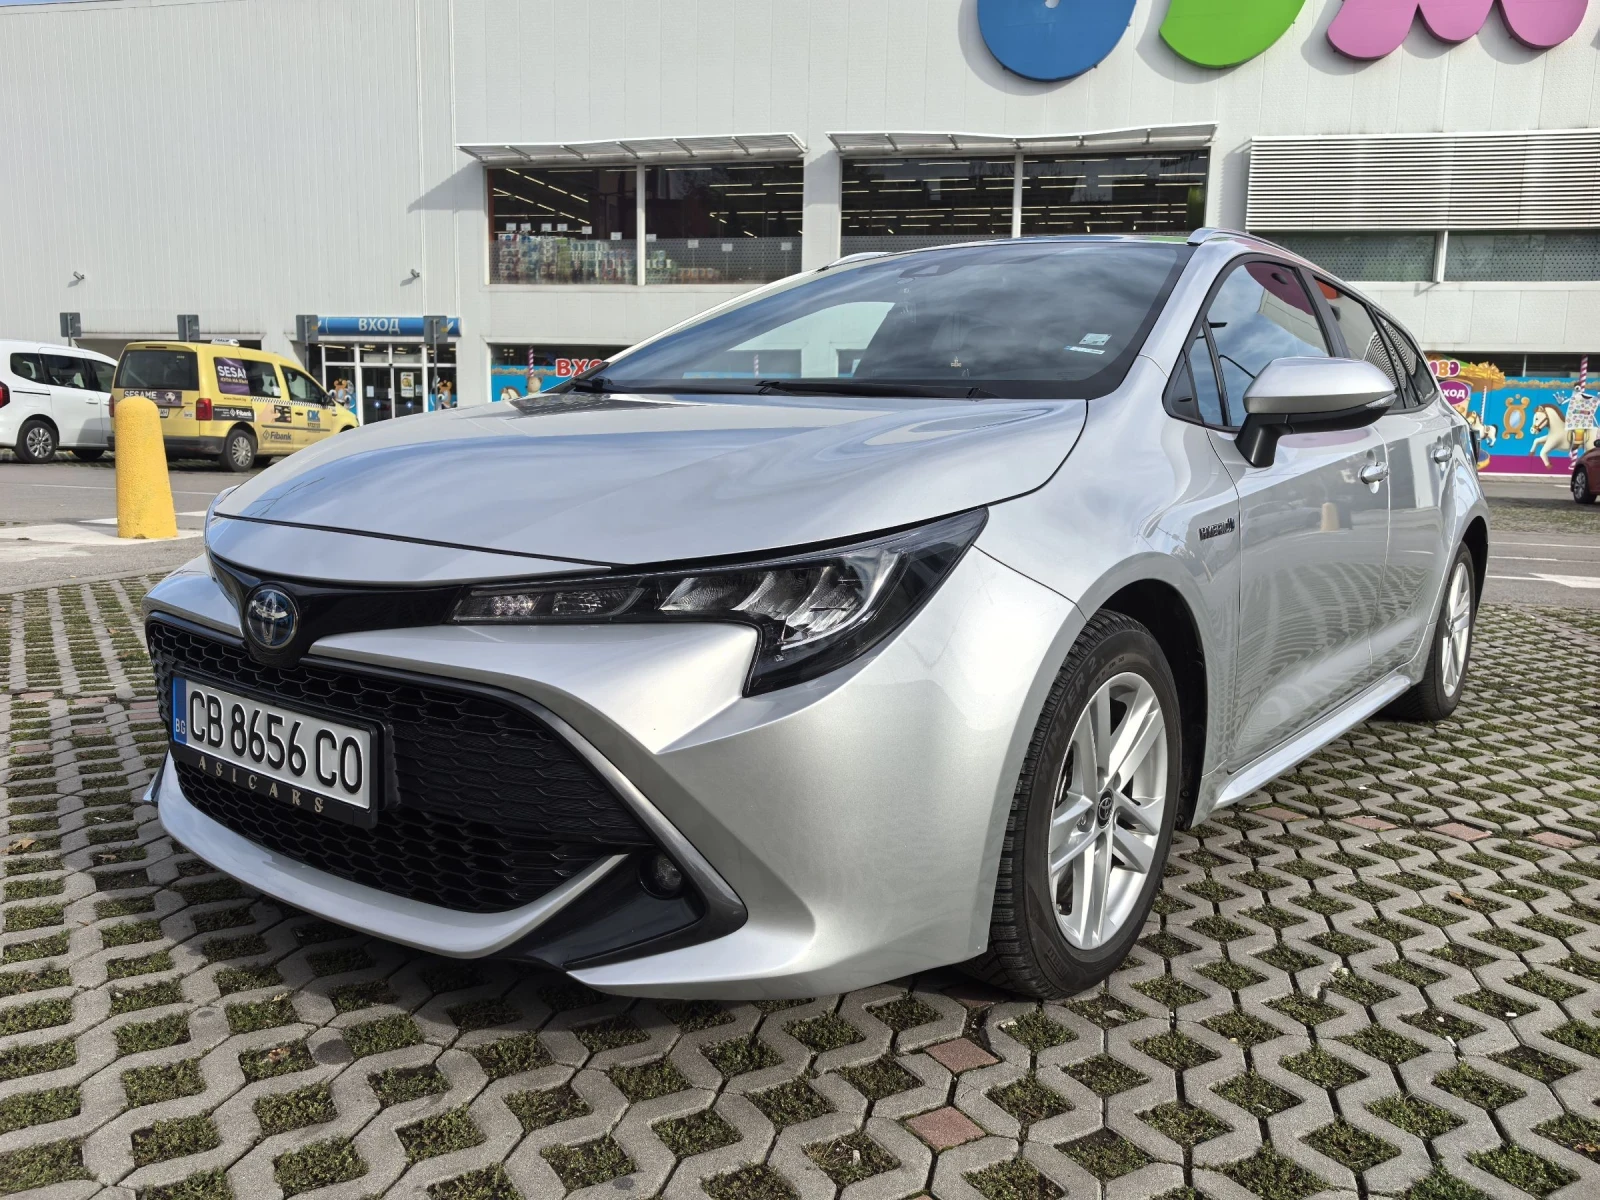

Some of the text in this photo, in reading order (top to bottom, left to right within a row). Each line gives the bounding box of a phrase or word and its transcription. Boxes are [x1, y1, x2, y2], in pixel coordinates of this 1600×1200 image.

[358, 318, 400, 334] ВХОД
[236, 409, 252, 417] Fibank
[270, 431, 291, 441] Fibank
[175, 718, 186, 735] BG
[190, 690, 363, 794] CB 8656 CO
[199, 756, 324, 813] ASICARS
